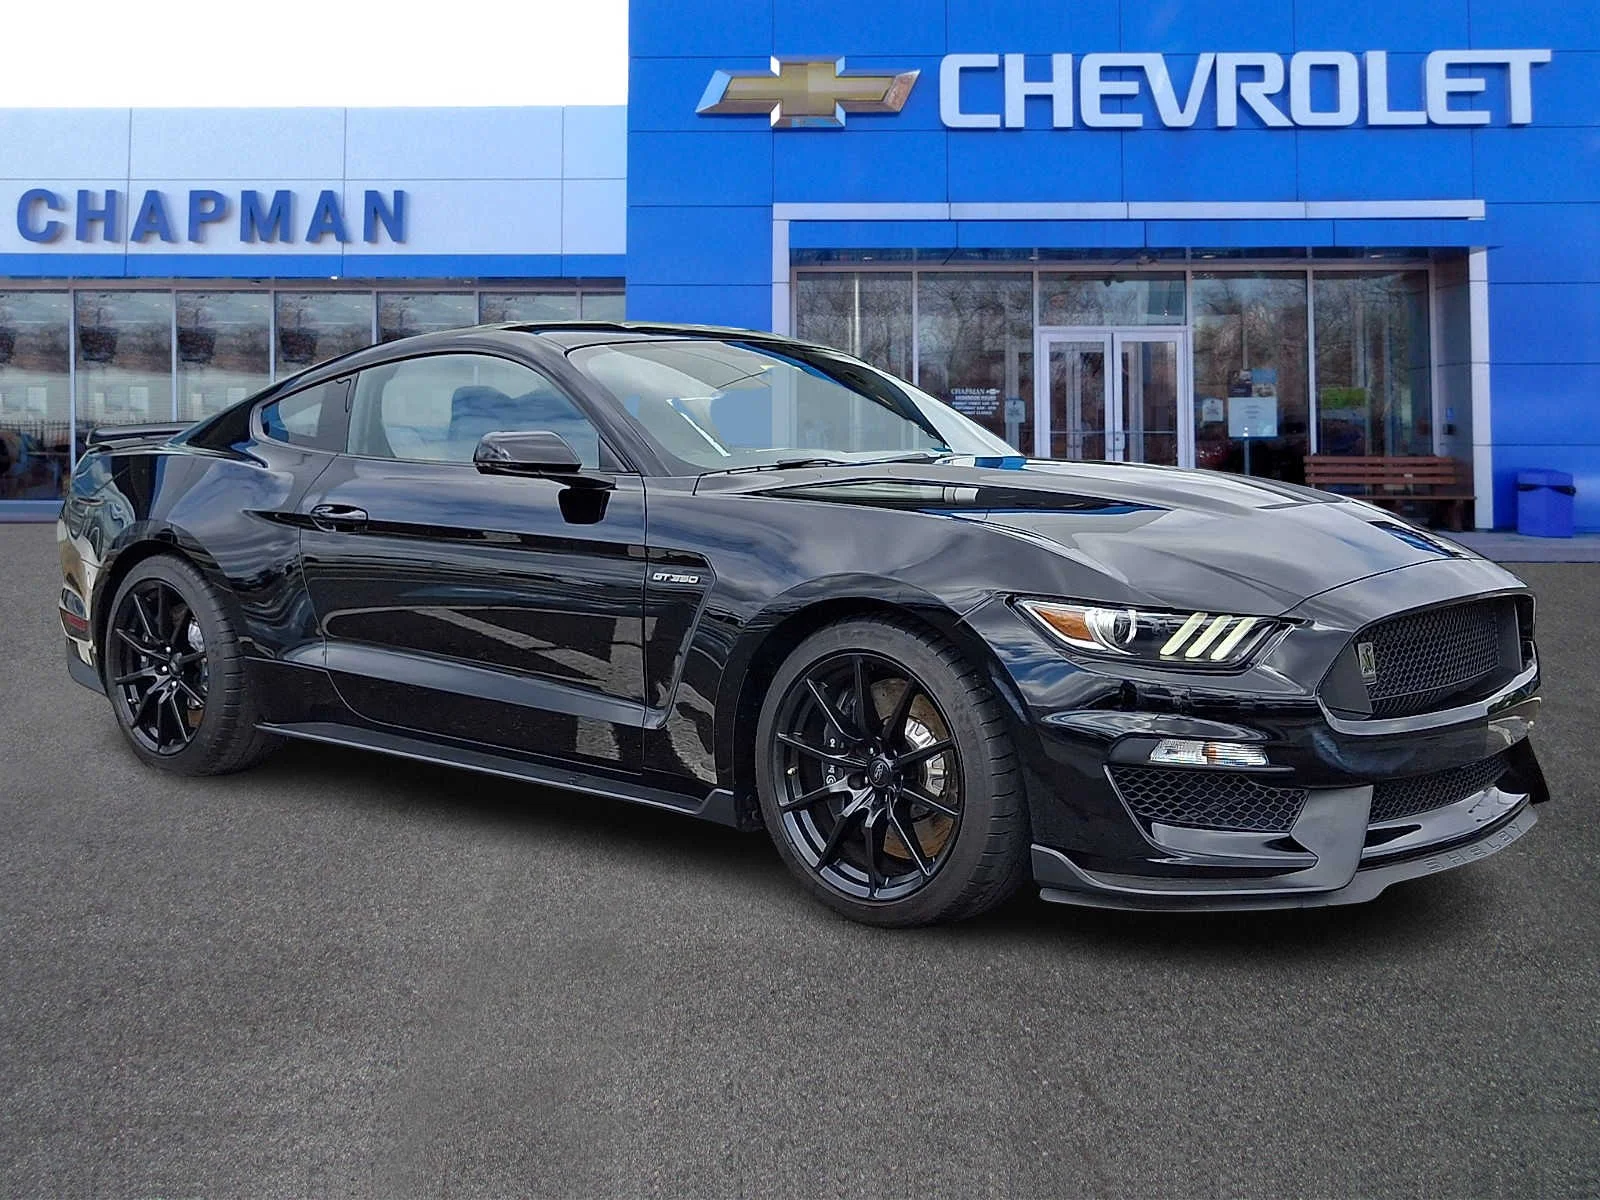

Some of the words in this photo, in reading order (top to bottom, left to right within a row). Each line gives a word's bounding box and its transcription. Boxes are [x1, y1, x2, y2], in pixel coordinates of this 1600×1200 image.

[939, 50, 1551, 128] CHEVROLET
[16, 188, 408, 243] CHAPMAN
[1423, 822, 1522, 872] SHELBY
